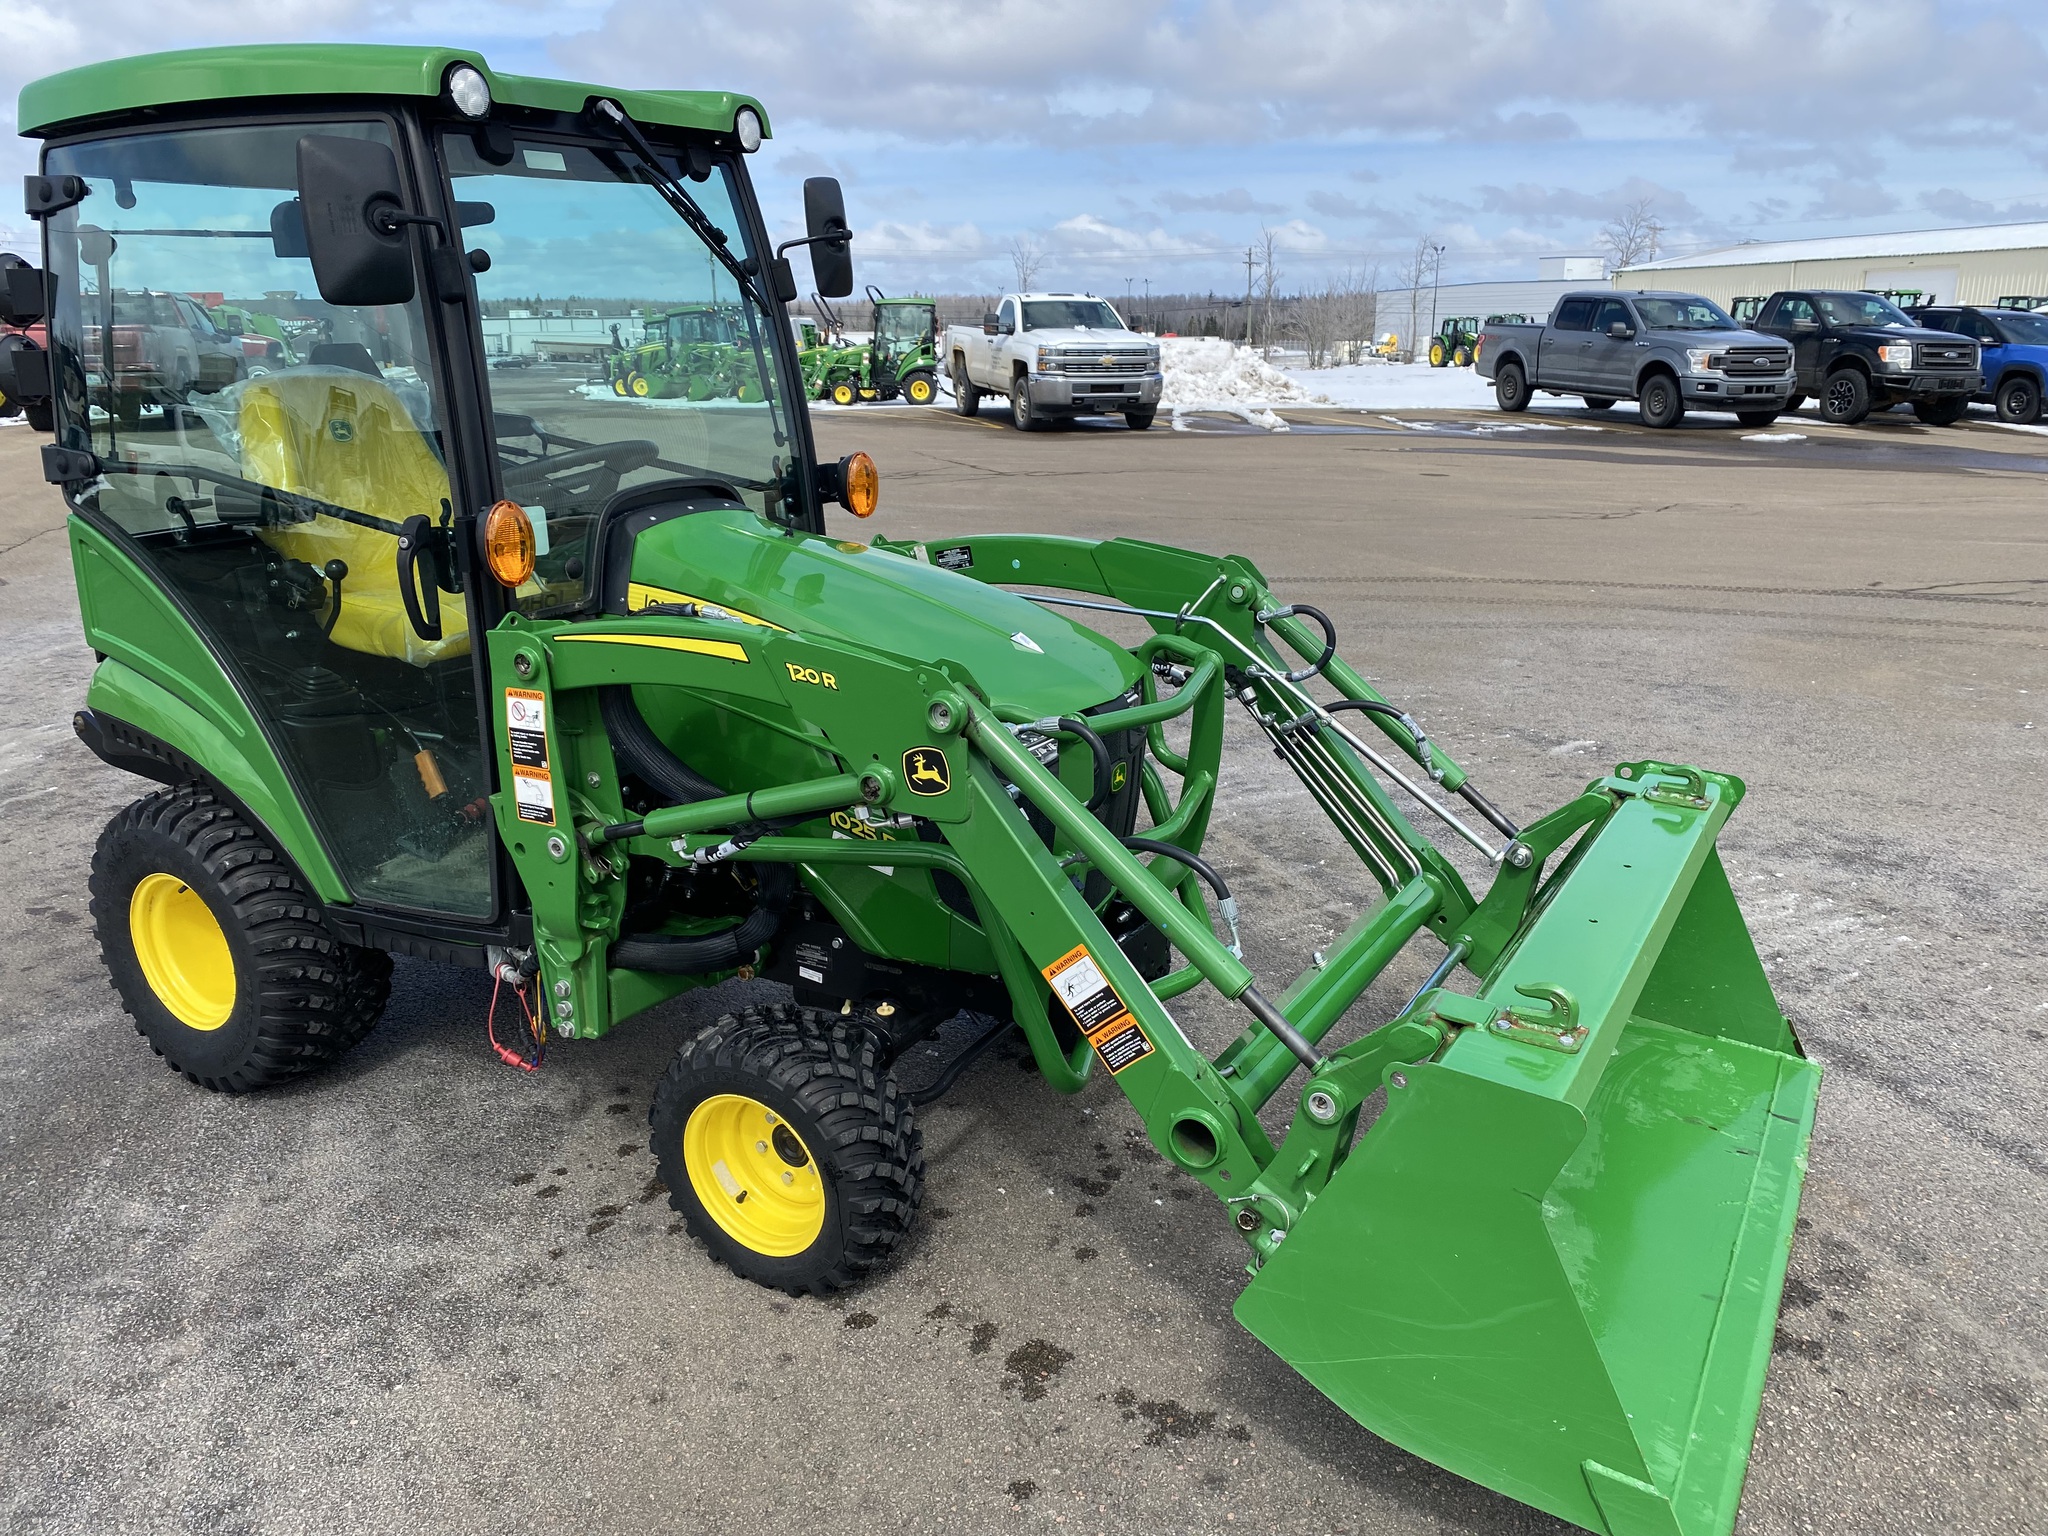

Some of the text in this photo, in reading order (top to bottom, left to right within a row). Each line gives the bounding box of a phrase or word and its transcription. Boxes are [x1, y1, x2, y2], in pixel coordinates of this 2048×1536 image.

[513, 690, 543, 700] WARNING
[520, 770, 549, 780] WARNING
[1055, 950, 1083, 971] WARNING
[1102, 1019, 1131, 1039] WARNING
